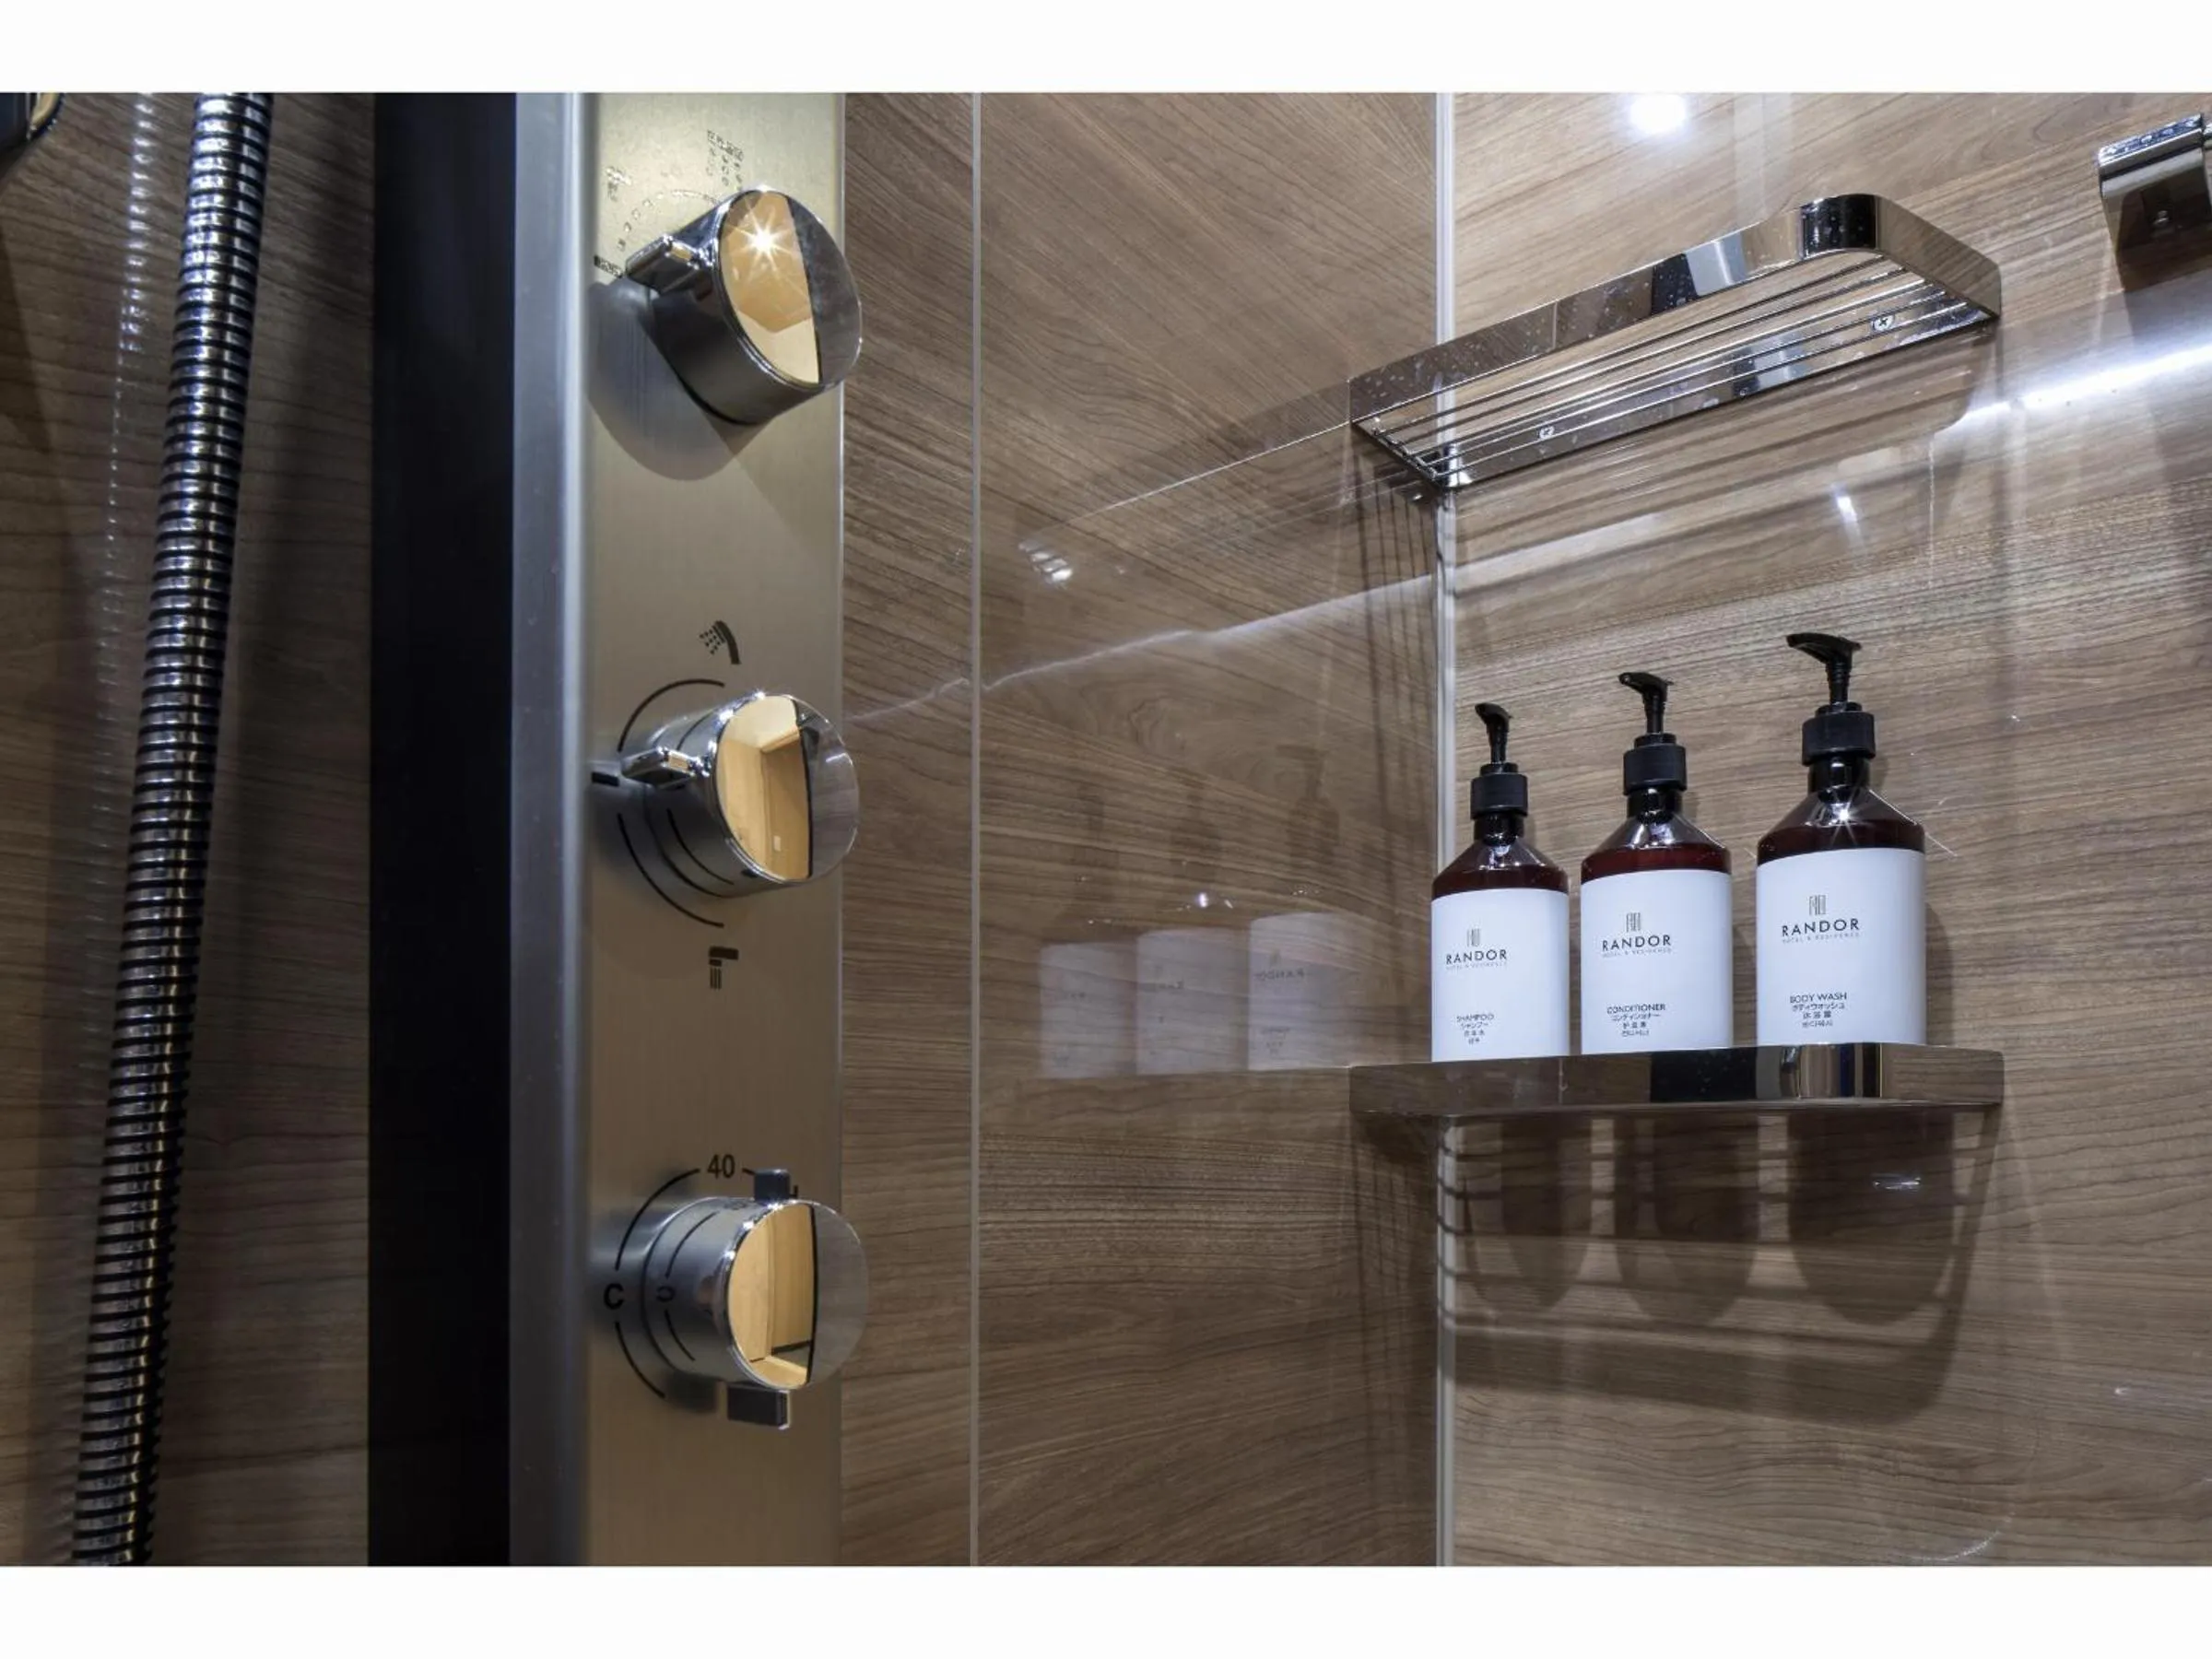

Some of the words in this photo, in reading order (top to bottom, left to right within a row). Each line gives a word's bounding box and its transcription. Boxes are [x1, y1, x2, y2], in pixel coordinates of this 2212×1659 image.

[1782, 918, 1860, 937] RANDOR
[1602, 935, 1671, 952] RANDOR
[1446, 949, 1507, 965] RANDOR
[1789, 994, 1816, 1004] BODY
[1817, 992, 1848, 1002] WASH
[1606, 1003, 1666, 1015] CONDITIONER
[1456, 1013, 1495, 1023] SHAMPOO
[707, 1154, 735, 1179] 40
[604, 1283, 625, 1310] C
